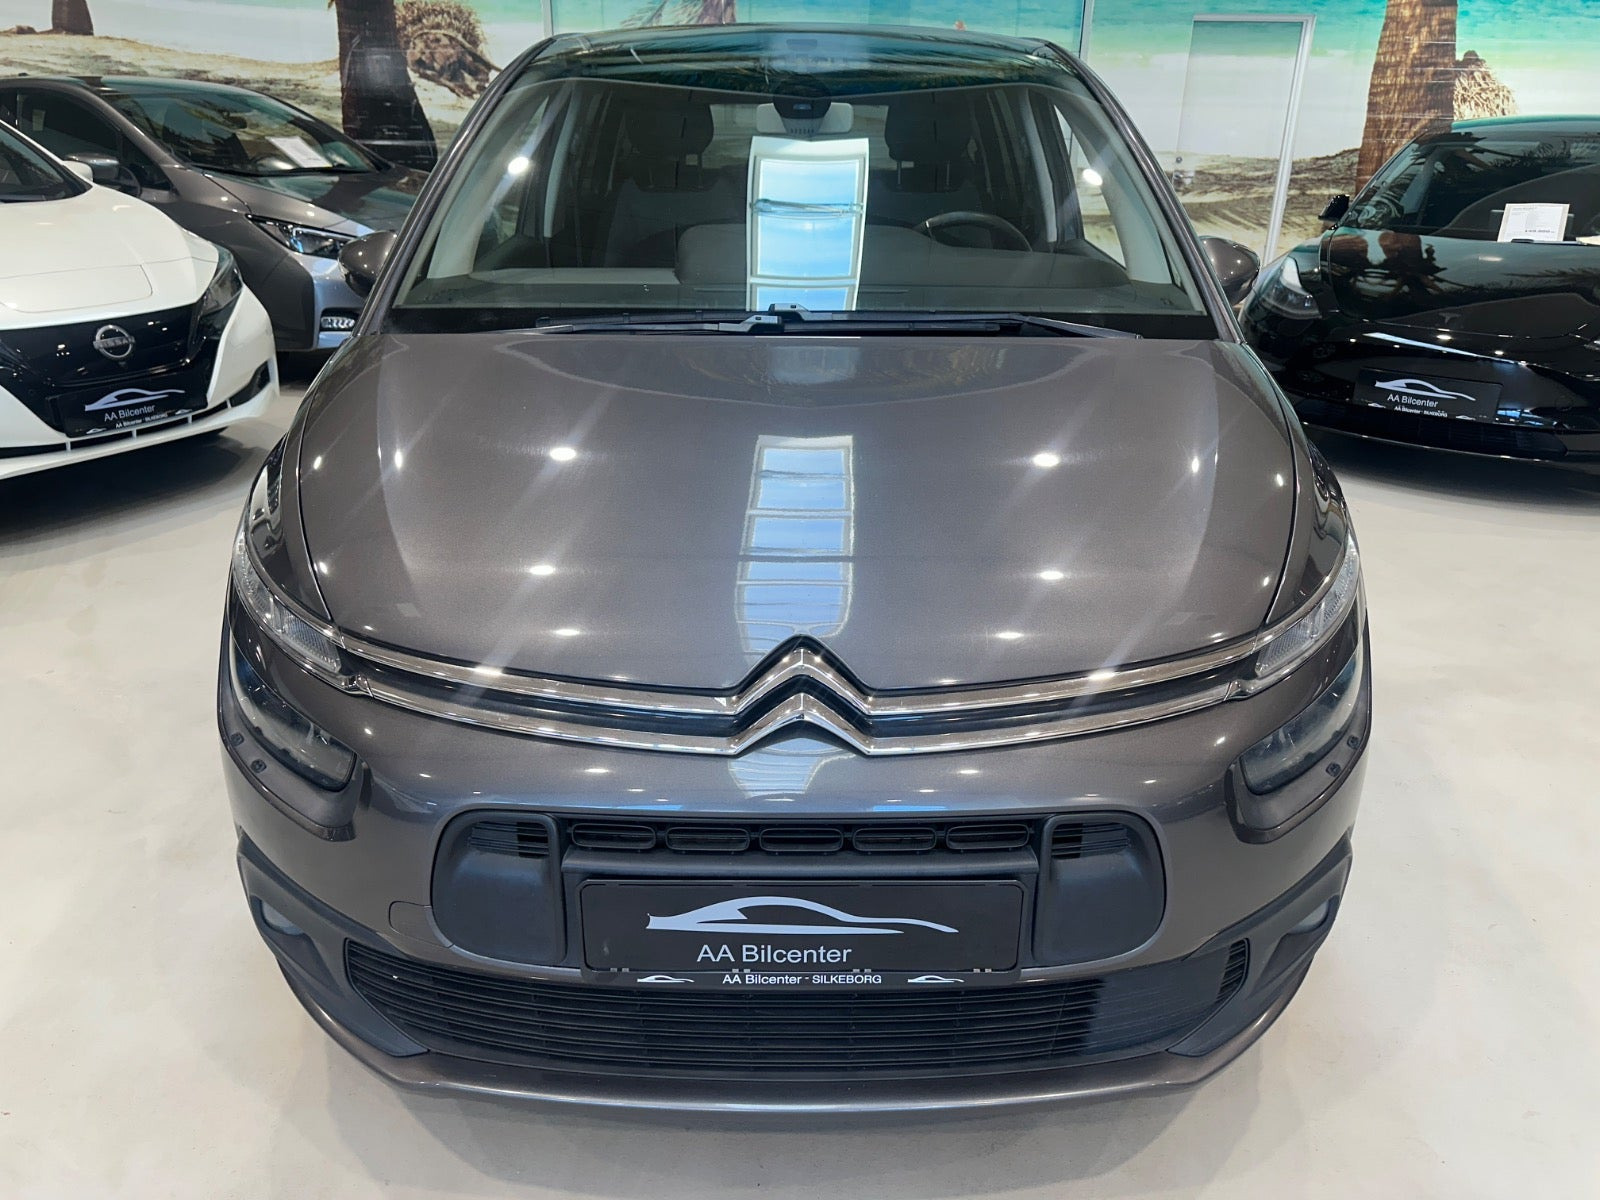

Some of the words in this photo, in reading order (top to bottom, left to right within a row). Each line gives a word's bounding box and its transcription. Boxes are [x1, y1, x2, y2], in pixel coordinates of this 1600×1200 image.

[1387, 394, 1400, 402] AA
[1402, 395, 1438, 407] Bilcenter
[104, 412, 118, 421] AA
[119, 405, 156, 418] Bilcenter
[696, 944, 735, 962] AA
[742, 944, 852, 963] Bilcenter
[722, 975, 742, 984] AA
[746, 974, 802, 985] Bilcenter
[812, 974, 882, 984] SILKEBORG
